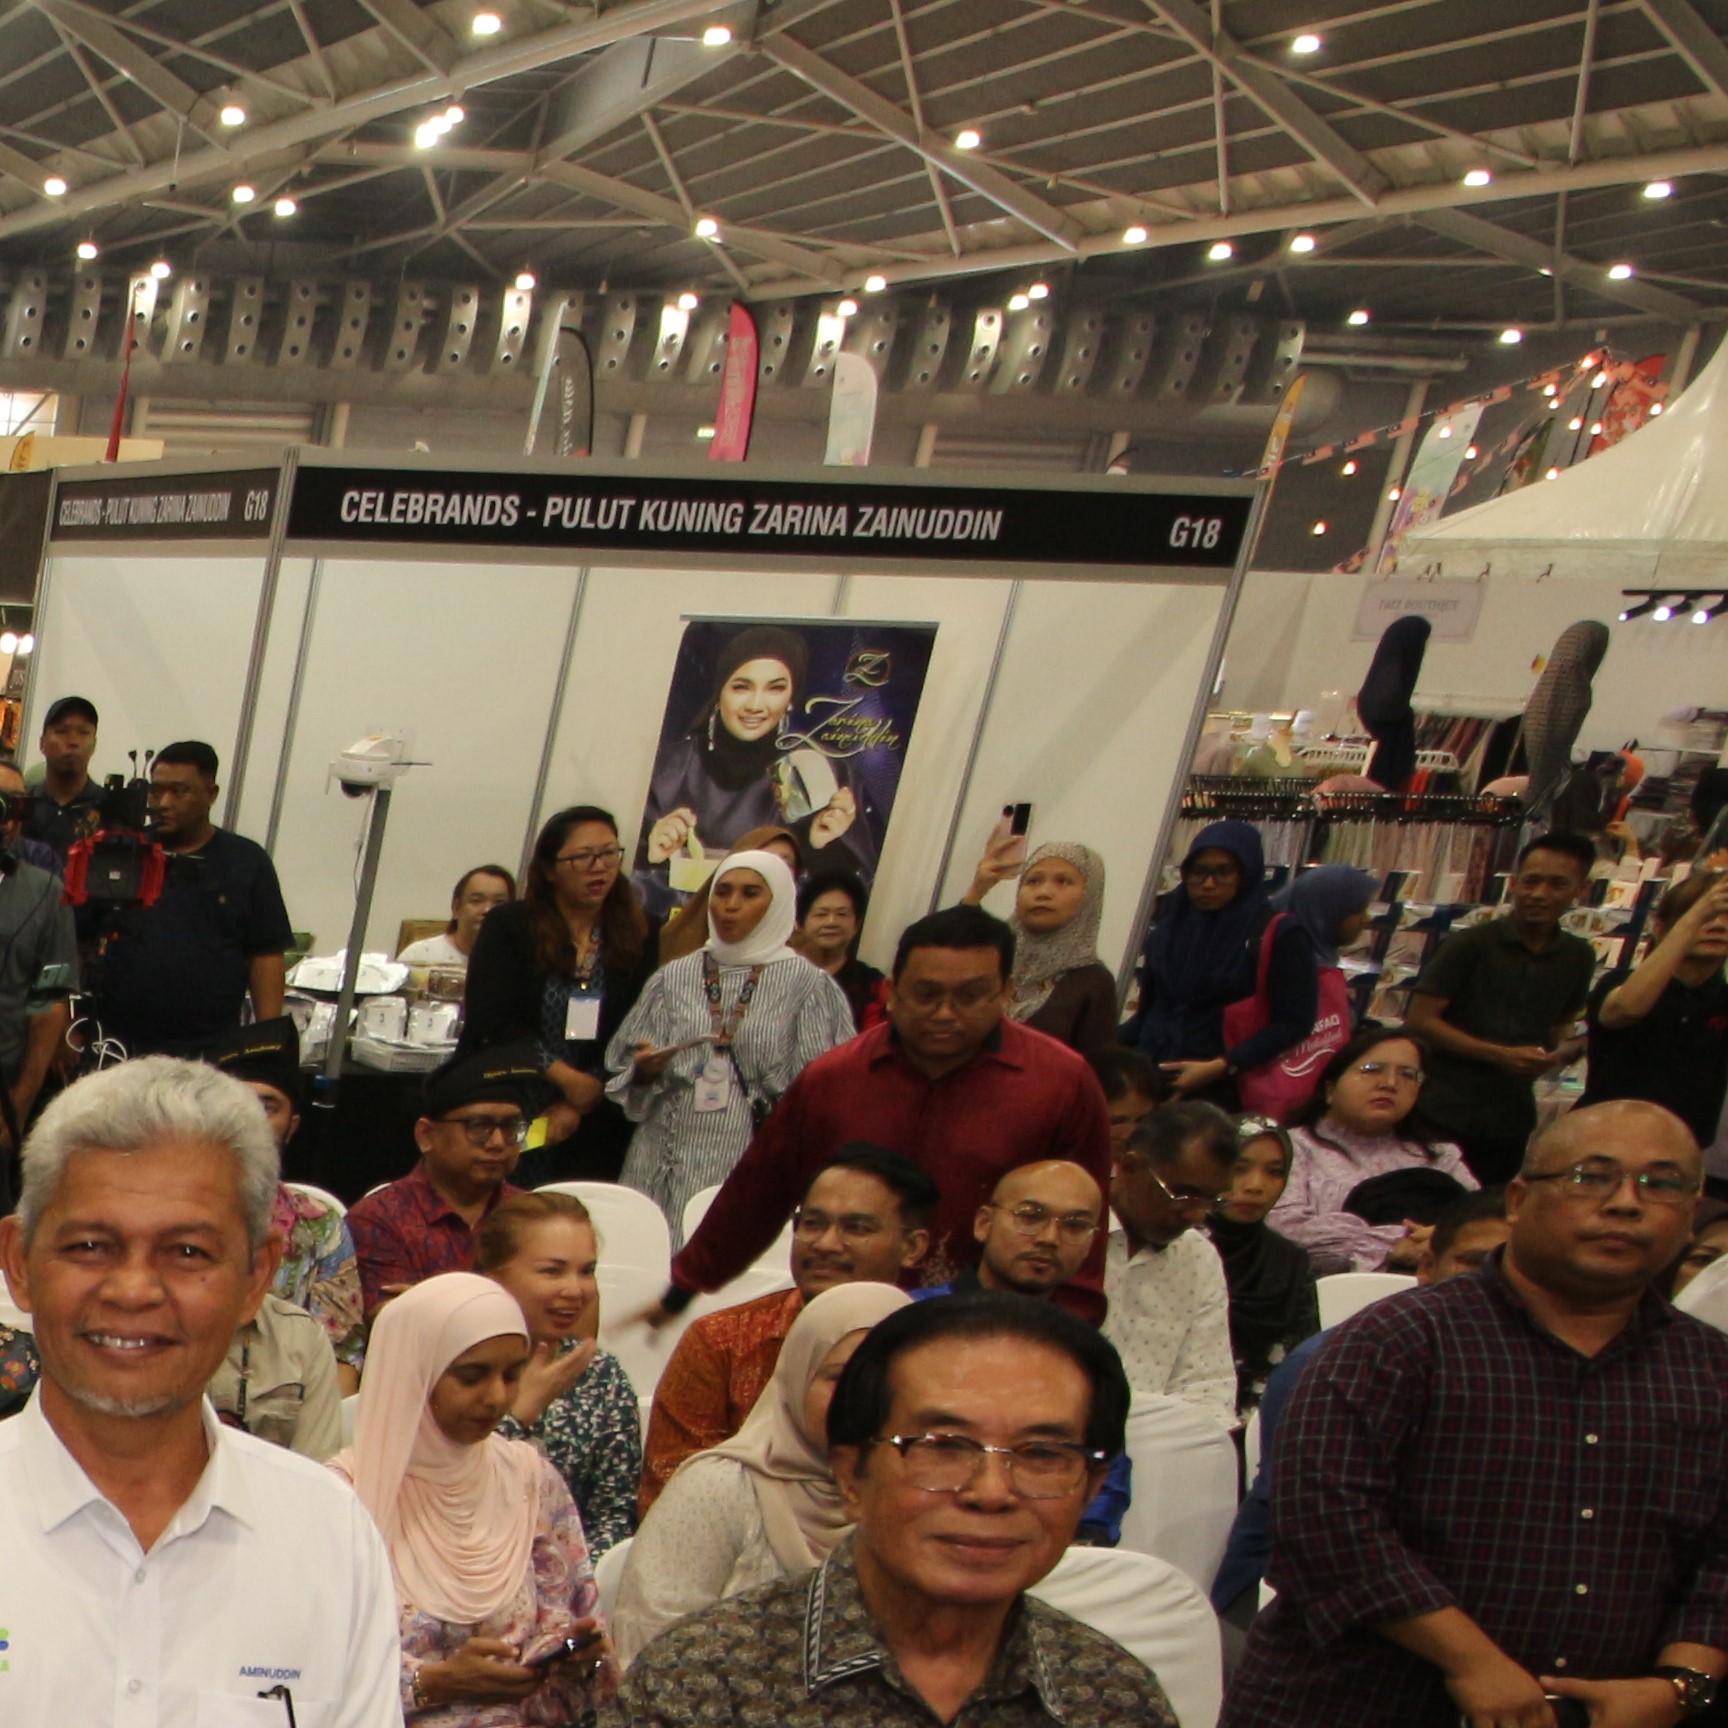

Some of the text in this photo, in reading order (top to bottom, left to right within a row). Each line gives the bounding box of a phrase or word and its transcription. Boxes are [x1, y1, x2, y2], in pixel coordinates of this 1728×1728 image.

[244, 490, 269, 521] G18
[340, 489, 518, 527] CELEBRANDS
[544, 495, 635, 530] PULUT
[638, 499, 743, 535] KUNING
[748, 503, 848, 537] ZARINA
[853, 506, 1003, 541] ZAINUDDIN
[1168, 517, 1222, 549] G18
[239, 1665, 302, 1681] AMINUDDIN
